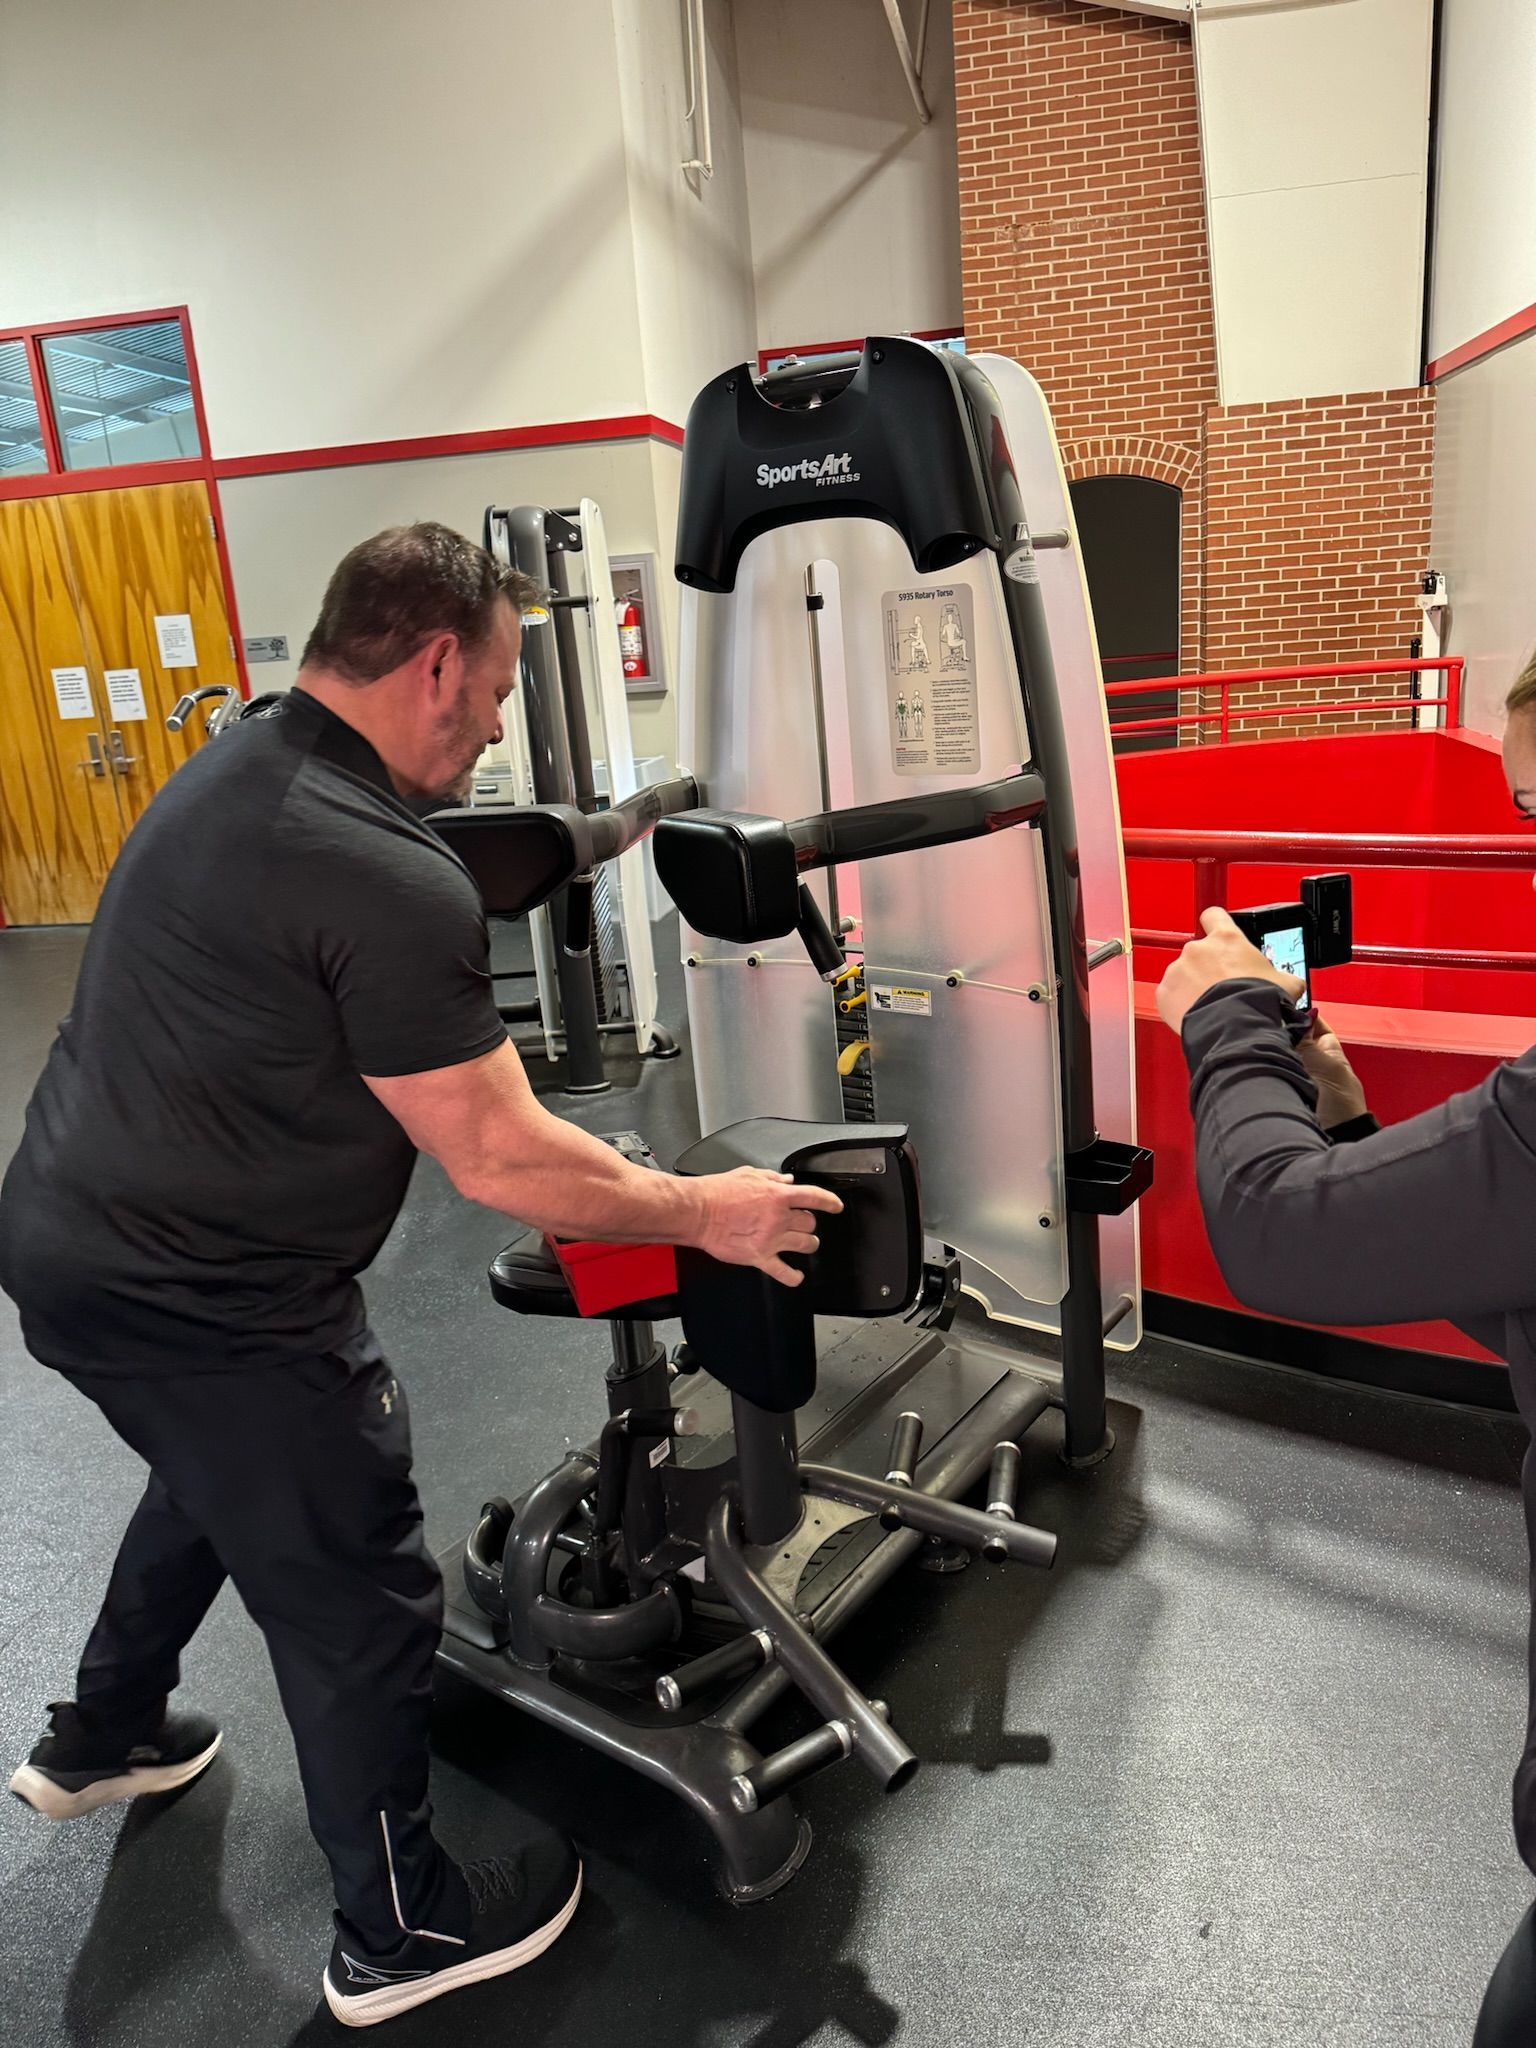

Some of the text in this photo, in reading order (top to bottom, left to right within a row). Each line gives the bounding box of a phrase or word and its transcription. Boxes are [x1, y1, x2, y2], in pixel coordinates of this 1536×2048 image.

[756, 453, 852, 488] SportsArt
[815, 473, 861, 487] FITNESS
[914, 591, 935, 600] Rotary
[936, 589, 953, 597] Torso
